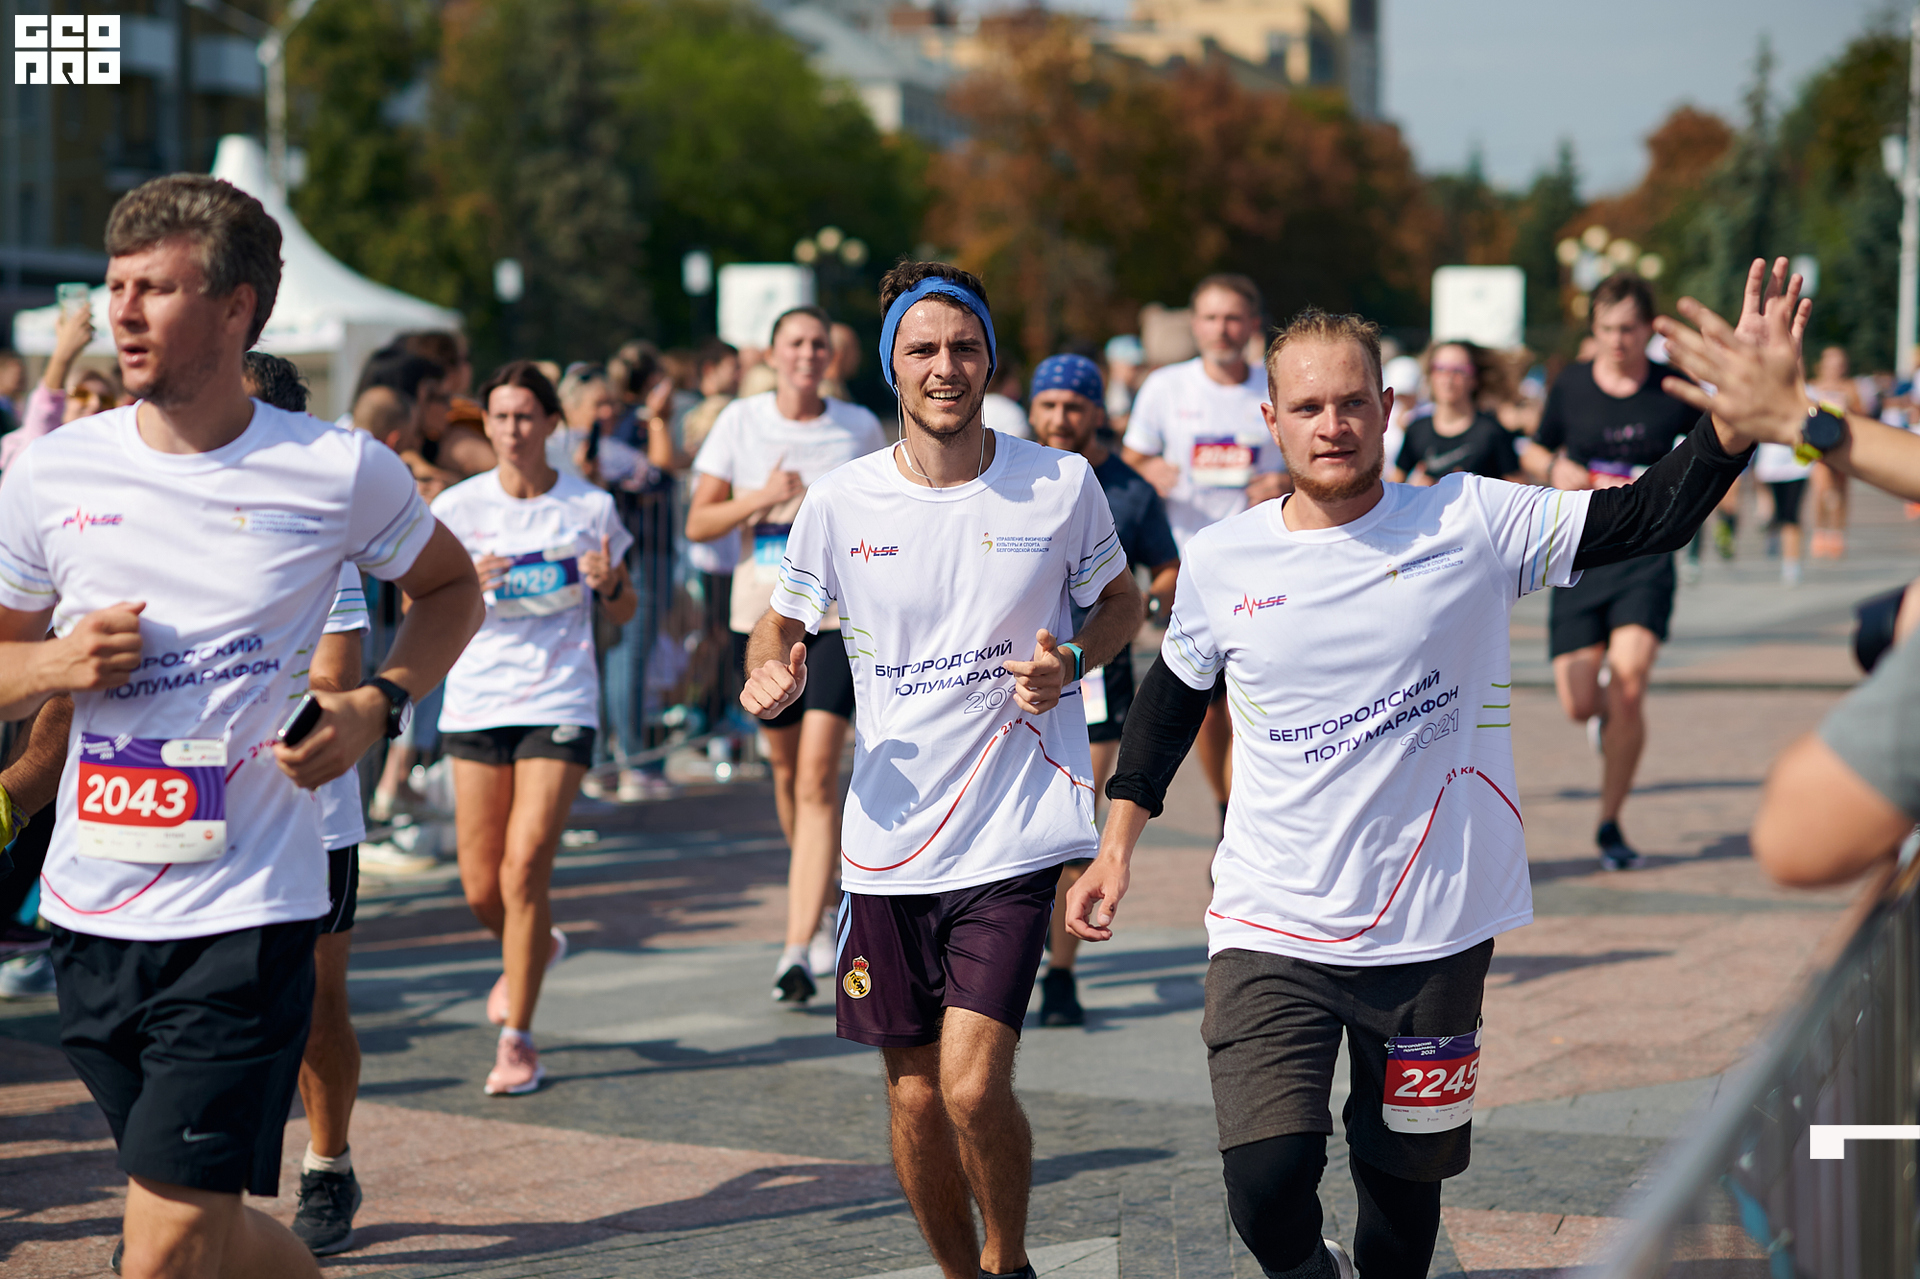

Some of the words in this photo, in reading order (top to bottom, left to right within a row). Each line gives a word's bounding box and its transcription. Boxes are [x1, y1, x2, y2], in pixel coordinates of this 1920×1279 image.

[503, 566, 559, 597] 1029
[1269, 669, 1441, 742] БЕЛГОРОДСКИЙ
[1304, 685, 1459, 765] ПОЛУМАРАФОН
[1001, 721, 1013, 736] 21
[1400, 707, 1460, 762] 2021
[82, 773, 189, 819] 2043
[1446, 767, 1457, 785] 21
[1394, 1057, 1480, 1098] 2245
